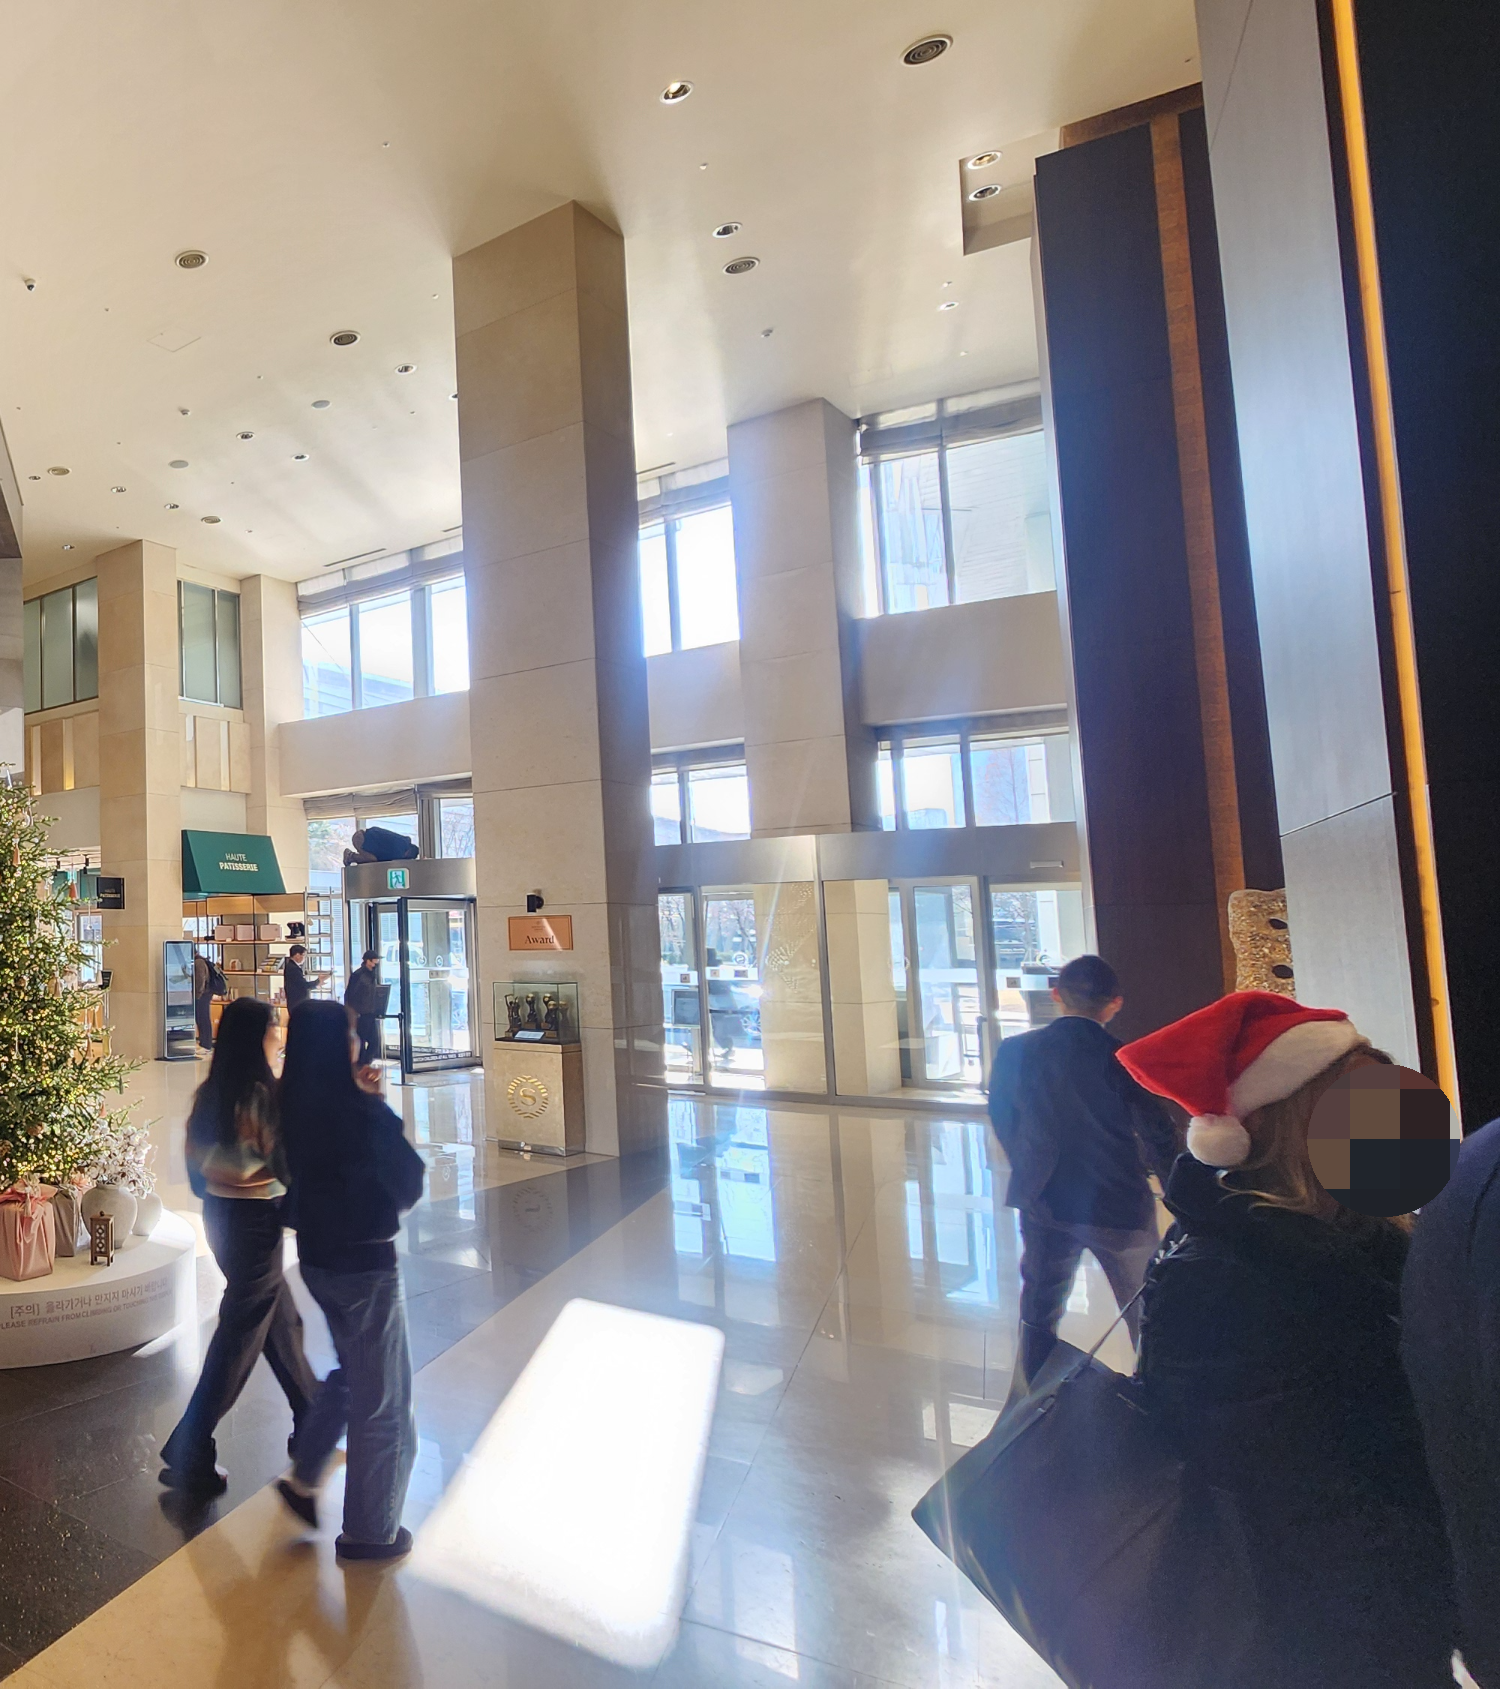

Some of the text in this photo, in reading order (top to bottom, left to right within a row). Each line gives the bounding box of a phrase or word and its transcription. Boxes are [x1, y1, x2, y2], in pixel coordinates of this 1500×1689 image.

[225, 853, 247, 862] HAUTE
[219, 862, 258, 871] PATISSERIE
[525, 935, 555, 944] Award
[10, 1303, 40, 1319] [주의]
[46, 1295, 92, 1314] 올라가거나
[94, 1290, 120, 1305] 만지지
[121, 1284, 143, 1299] 마시기
[28, 1315, 60, 1327] REFRAIN
[61, 1311, 81, 1321] FROM
[81, 1306, 112, 1318] CLIMBING
[113, 1303, 122, 1312] OR
